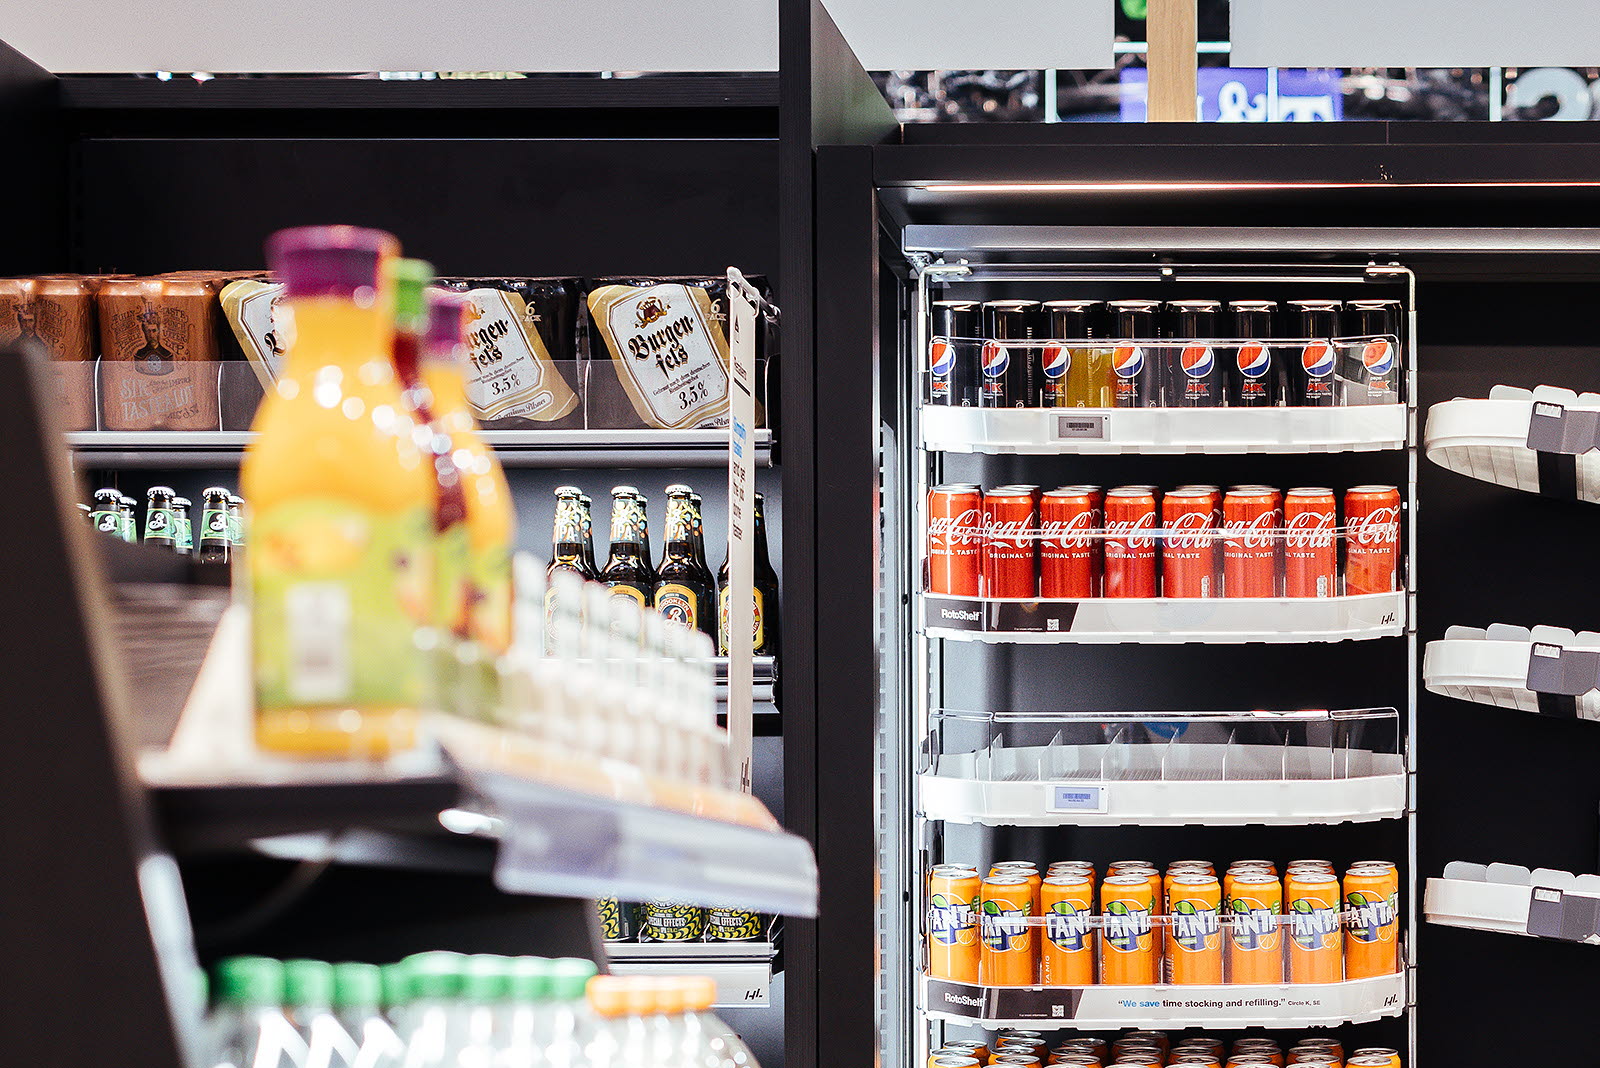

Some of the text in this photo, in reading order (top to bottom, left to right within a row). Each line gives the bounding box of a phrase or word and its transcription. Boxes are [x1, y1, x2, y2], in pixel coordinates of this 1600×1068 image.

[526, 301, 535, 315] 6
[710, 299, 721, 313] 6
[628, 315, 694, 360] Burgen-
[491, 372, 521, 396] 3,5%
[679, 379, 709, 410] 3,5%
[941, 608, 980, 621] RotoShelf
[662, 917, 686, 927] EFFECTS
[1162, 1000, 1183, 1008] time
[1185, 999, 1223, 1010] stocking
[1225, 999, 1242, 1008] and
